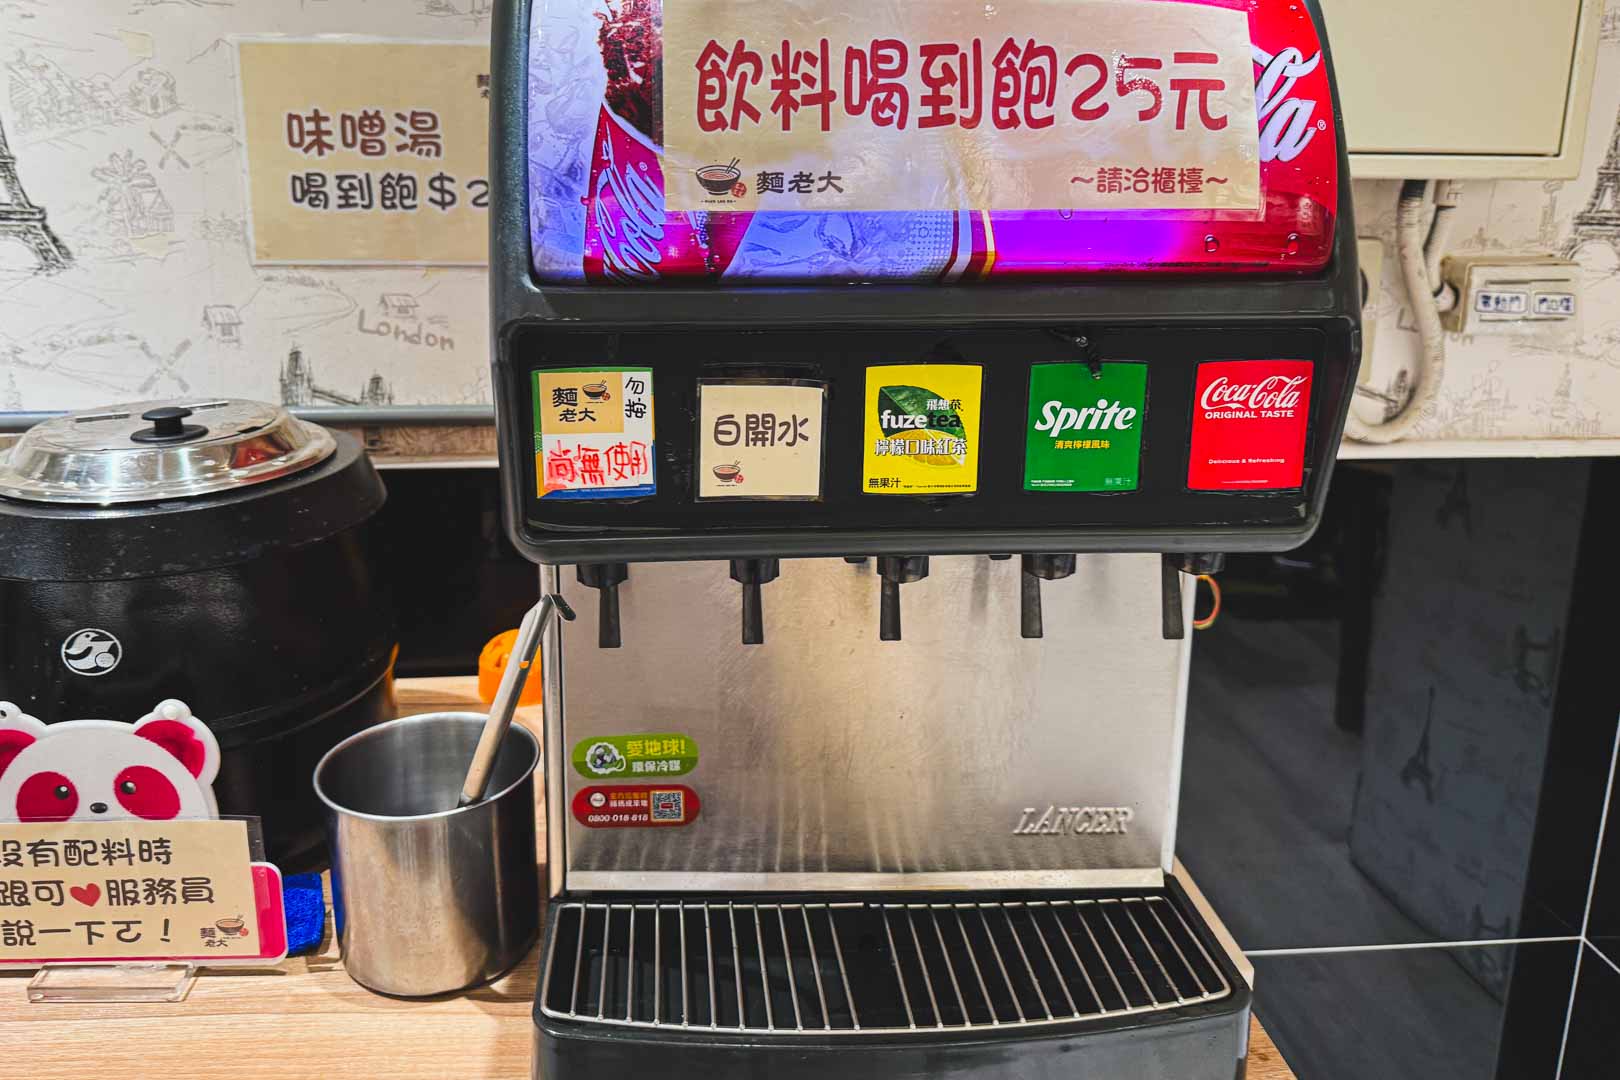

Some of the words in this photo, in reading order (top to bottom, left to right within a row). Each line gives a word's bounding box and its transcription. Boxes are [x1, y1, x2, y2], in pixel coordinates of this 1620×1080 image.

[696, 37, 1229, 132] 飲料喝到飽25元
[287, 110, 443, 157] 味噌湯
[756, 170, 844, 195] 麵老大
[358, 308, 455, 350] London
[1200, 376, 1307, 410] Coca-Cola
[559, 408, 597, 422] 老大
[1034, 399, 1137, 438] Sprite
[1204, 410, 1257, 420] ORIGINAL
[1260, 410, 1295, 418] TASTE
[713, 413, 809, 448] 白開水
[874, 438, 967, 457] 檸檬口味紅茶
[868, 477, 902, 489] 無果汁
[1012, 805, 1135, 835] LANCER
[106, 877, 215, 906] 服務員
